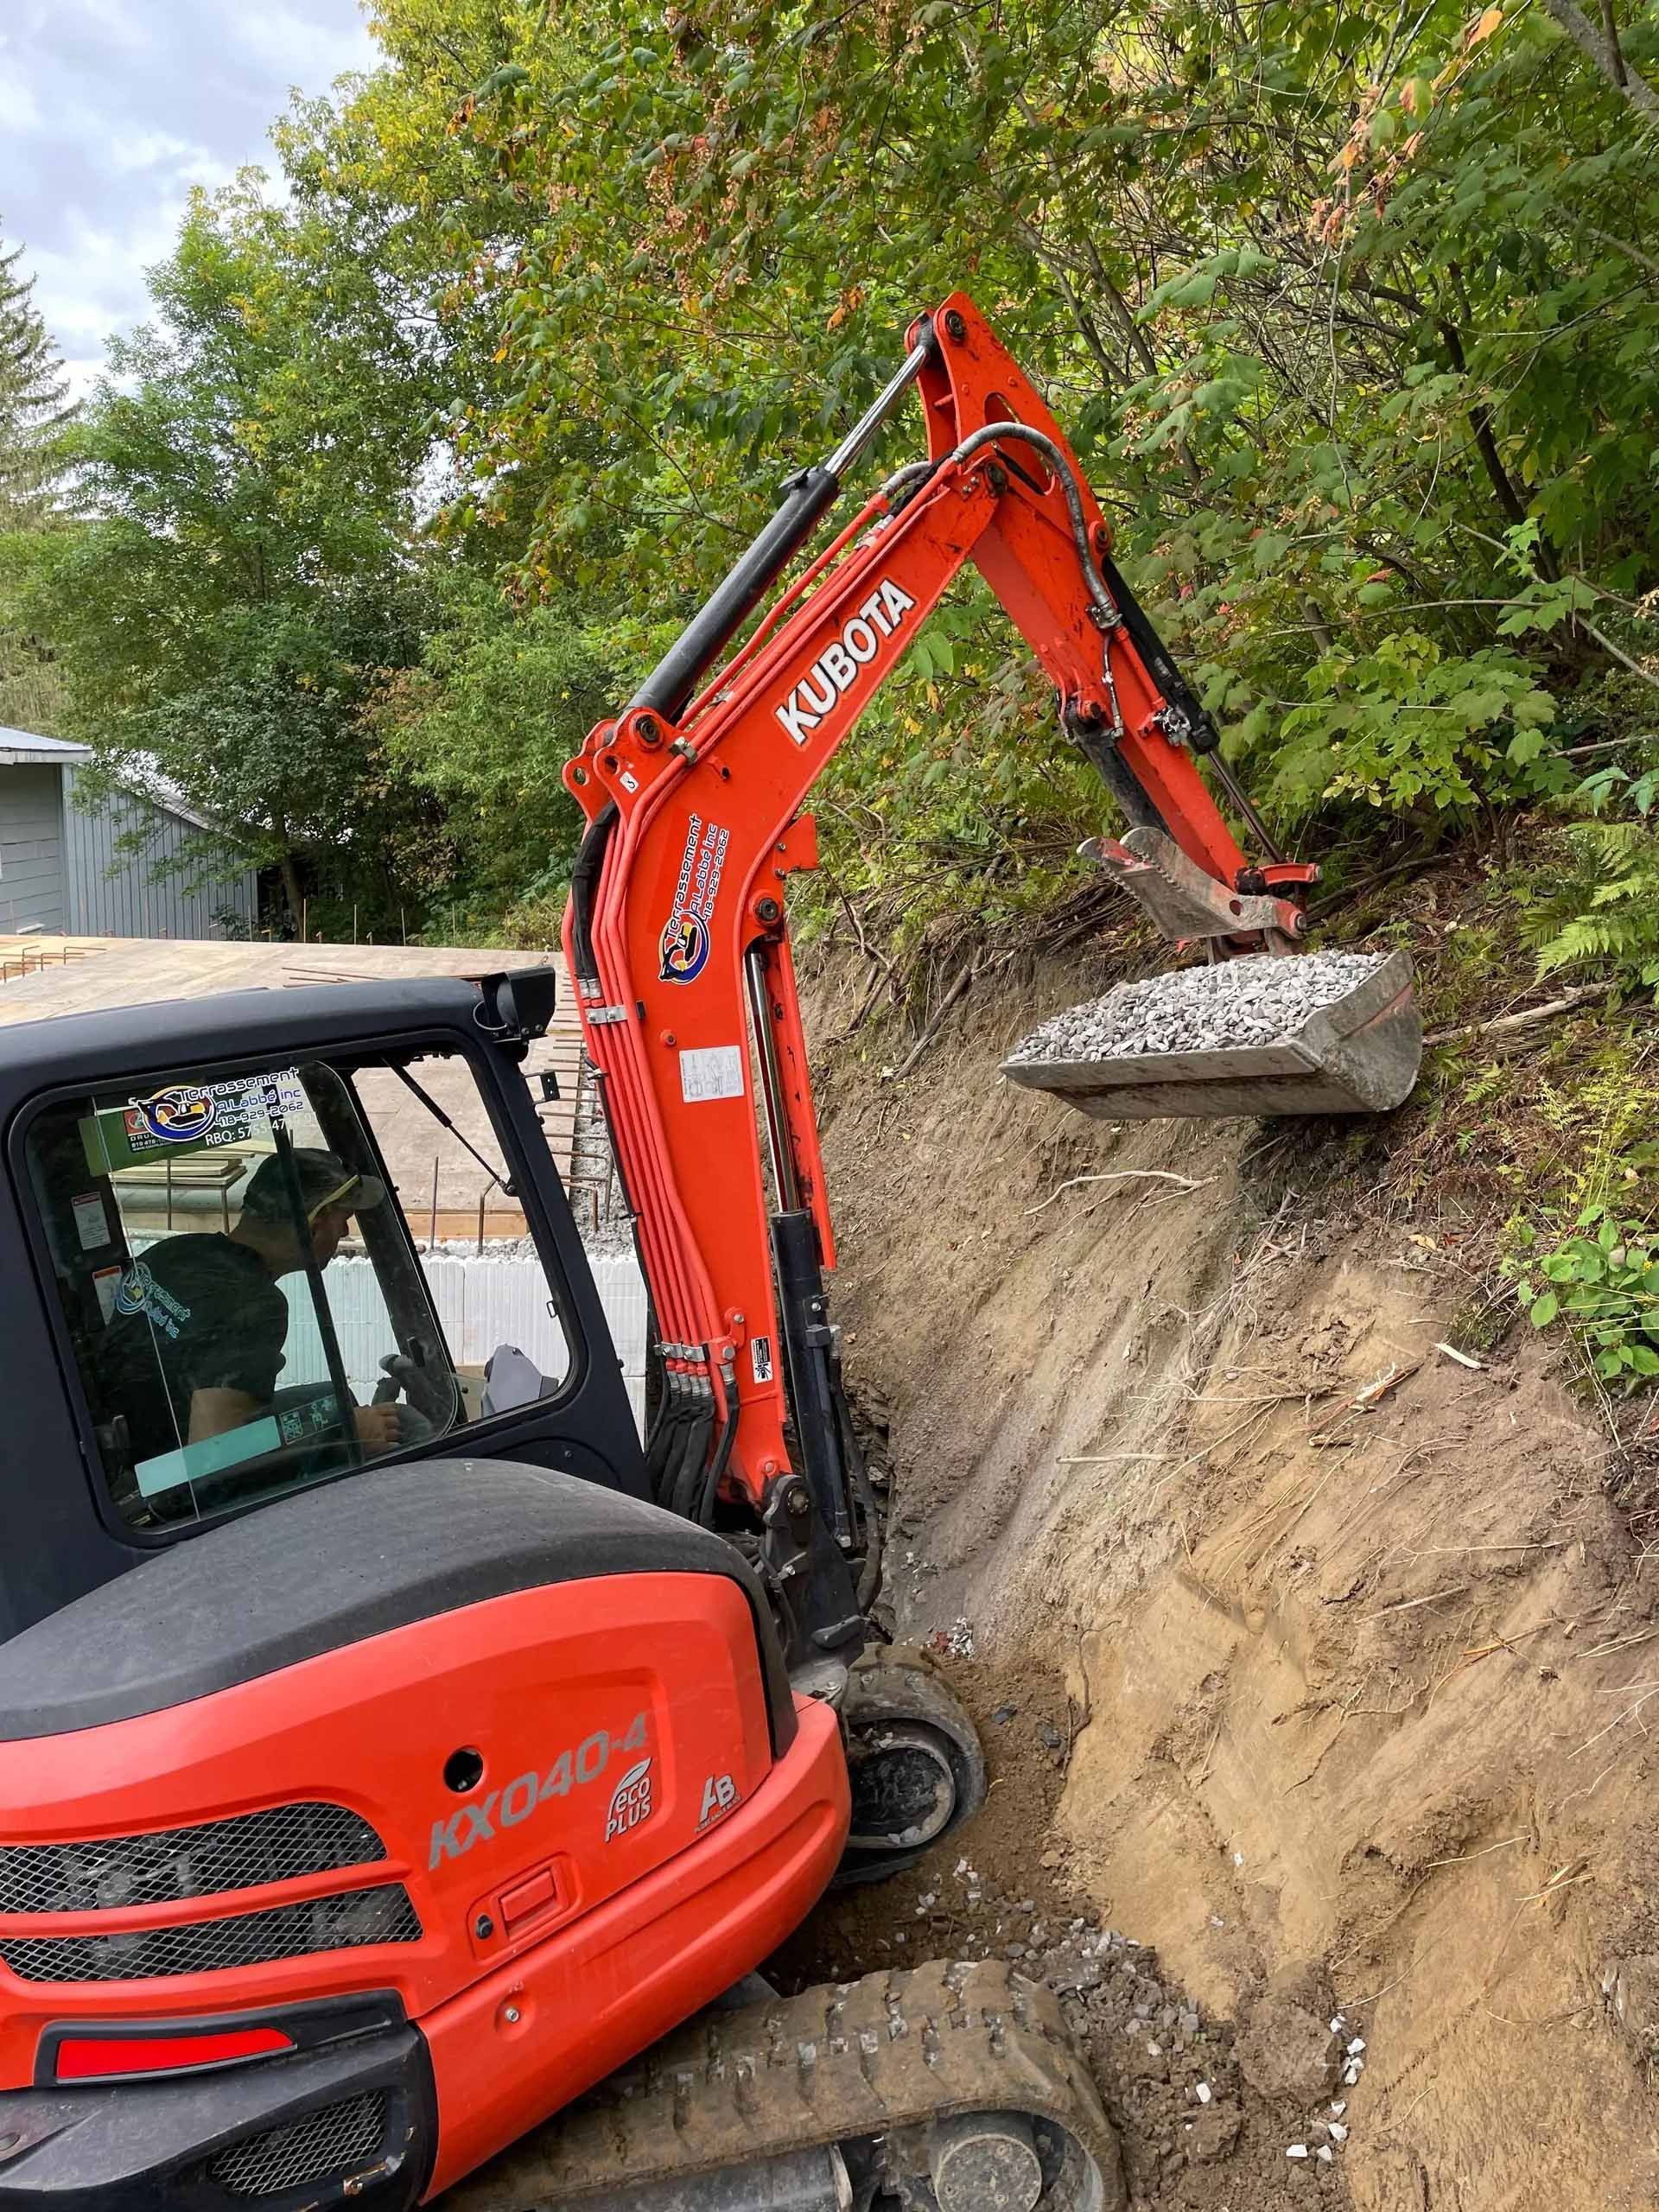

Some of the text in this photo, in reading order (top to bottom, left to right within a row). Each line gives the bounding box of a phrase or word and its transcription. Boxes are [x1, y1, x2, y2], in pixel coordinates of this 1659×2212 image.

[774, 578, 917, 747] KUBOTA
[703, 823, 718, 849] inc
[664, 812, 703, 939] Terrassement
[702, 829, 729, 922] 418-929-2062
[179, 1066, 299, 1103] Terrassement
[279, 1087, 302, 1100] inc
[206, 1129, 236, 1147] RBQ:
[429, 1712, 647, 1871] KX040-4
[615, 1777, 651, 1813] eco
[605, 1796, 651, 1843] PLUS
